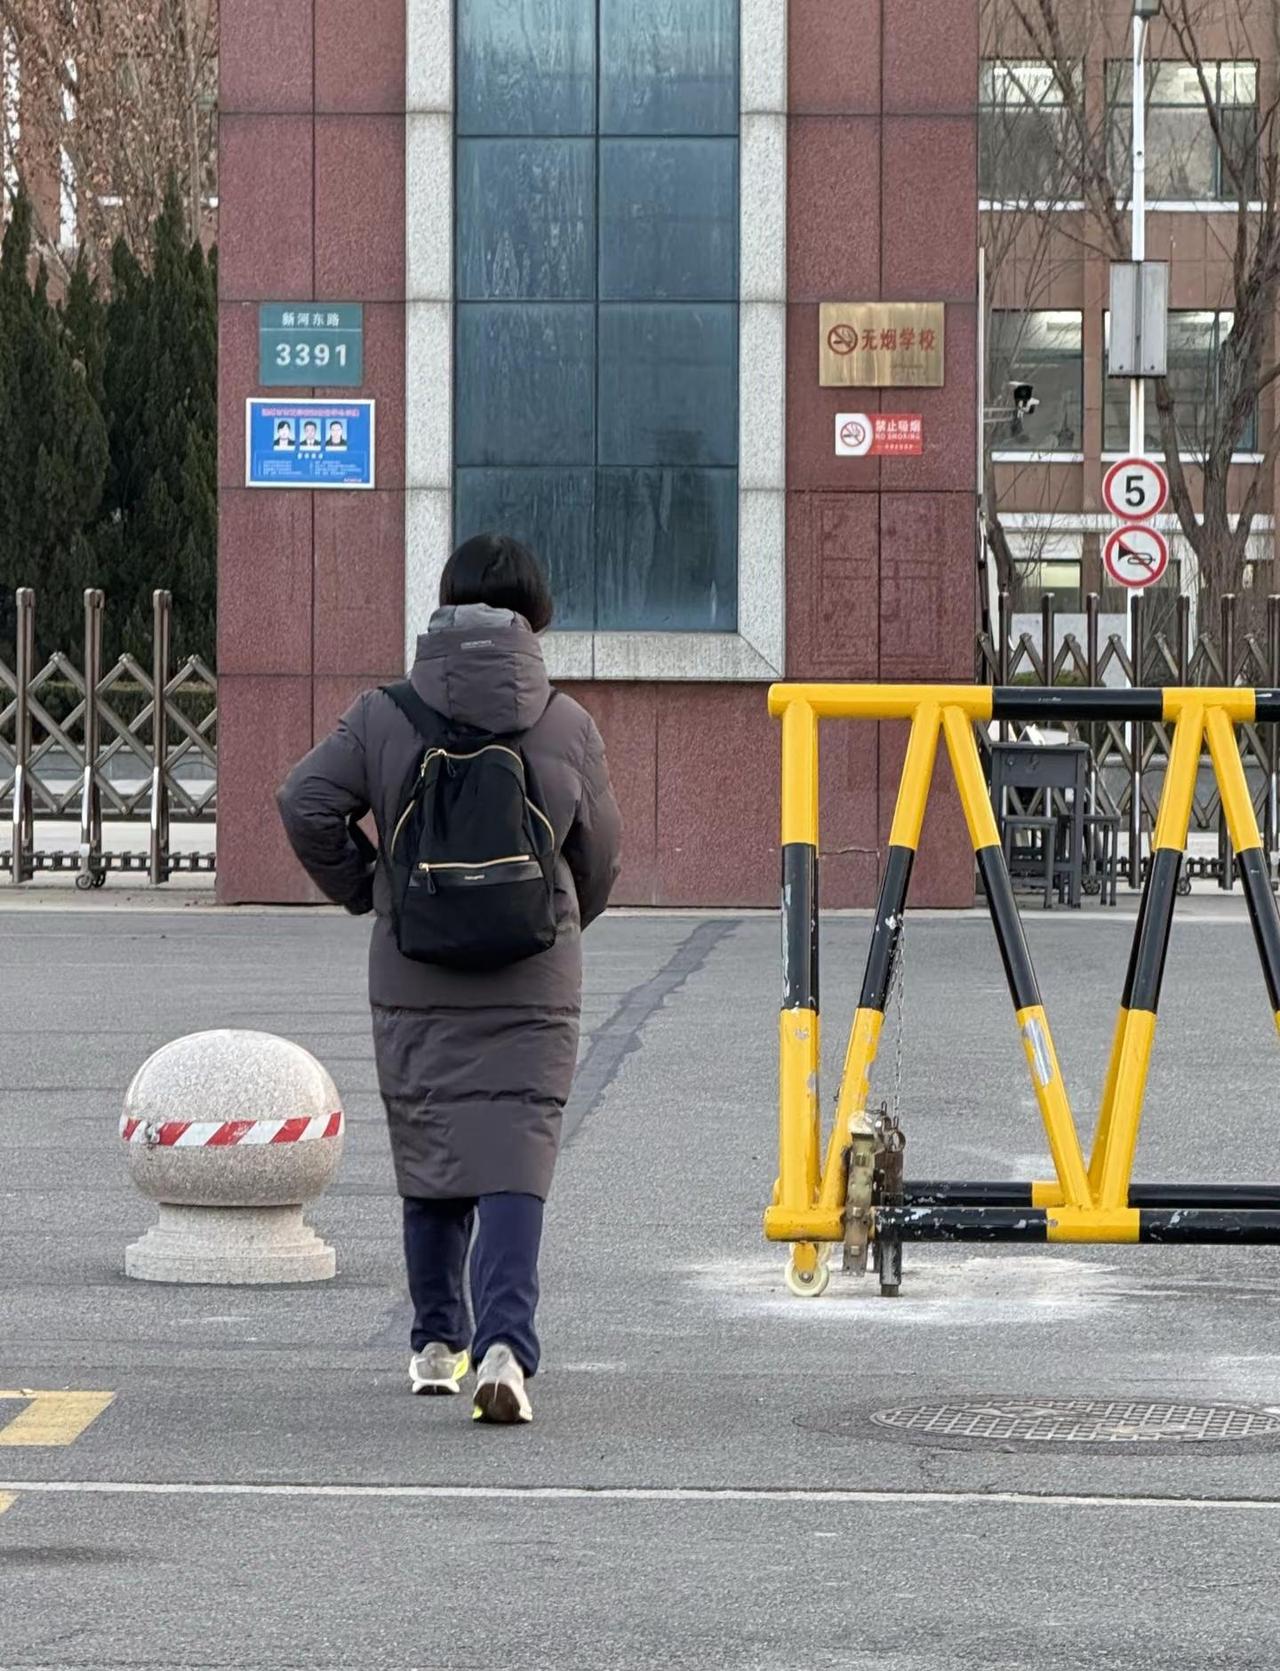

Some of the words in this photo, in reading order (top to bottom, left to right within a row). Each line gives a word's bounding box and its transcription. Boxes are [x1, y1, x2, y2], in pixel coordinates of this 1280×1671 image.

[281, 312, 340, 327] 新河东路
[862, 327, 935, 352] 无烟学校
[275, 343, 347, 367] 3391
[875, 419, 921, 433] 禁止吸烟
[1125, 475, 1145, 507] 5
